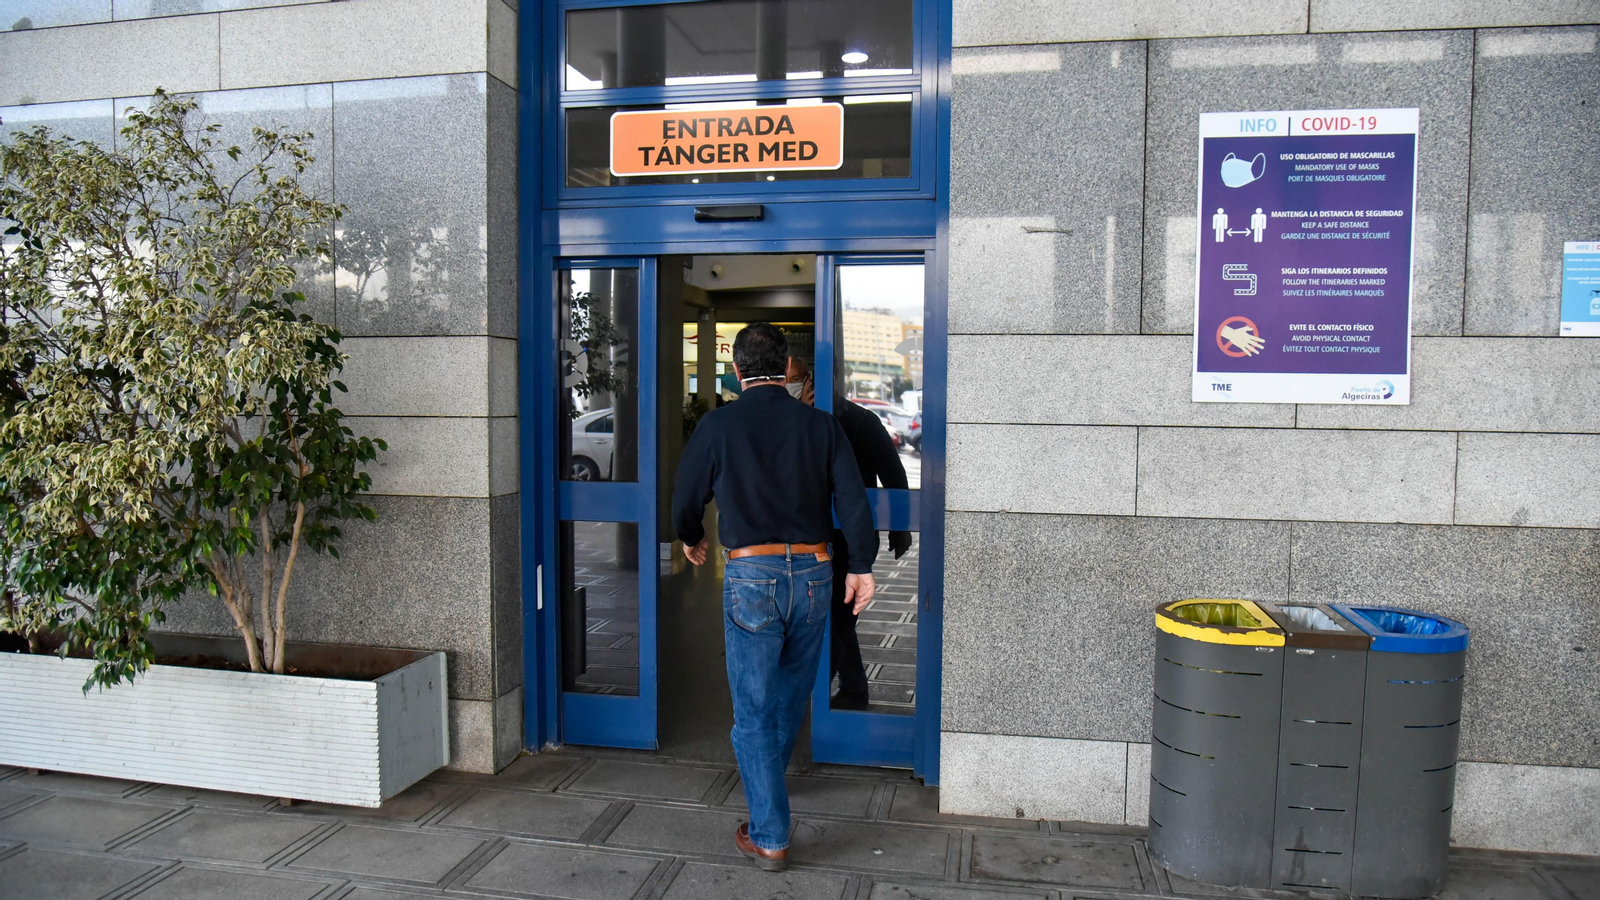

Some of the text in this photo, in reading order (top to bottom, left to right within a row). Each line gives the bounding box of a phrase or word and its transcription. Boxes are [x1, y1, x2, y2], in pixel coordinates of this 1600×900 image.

[663, 115, 794, 139] ENTRADA
[1240, 116, 1376, 132] INFO COVID-19
[638, 140, 818, 166] TÁNGER MED
[1354, 289, 1384, 297] MARQUÉS
